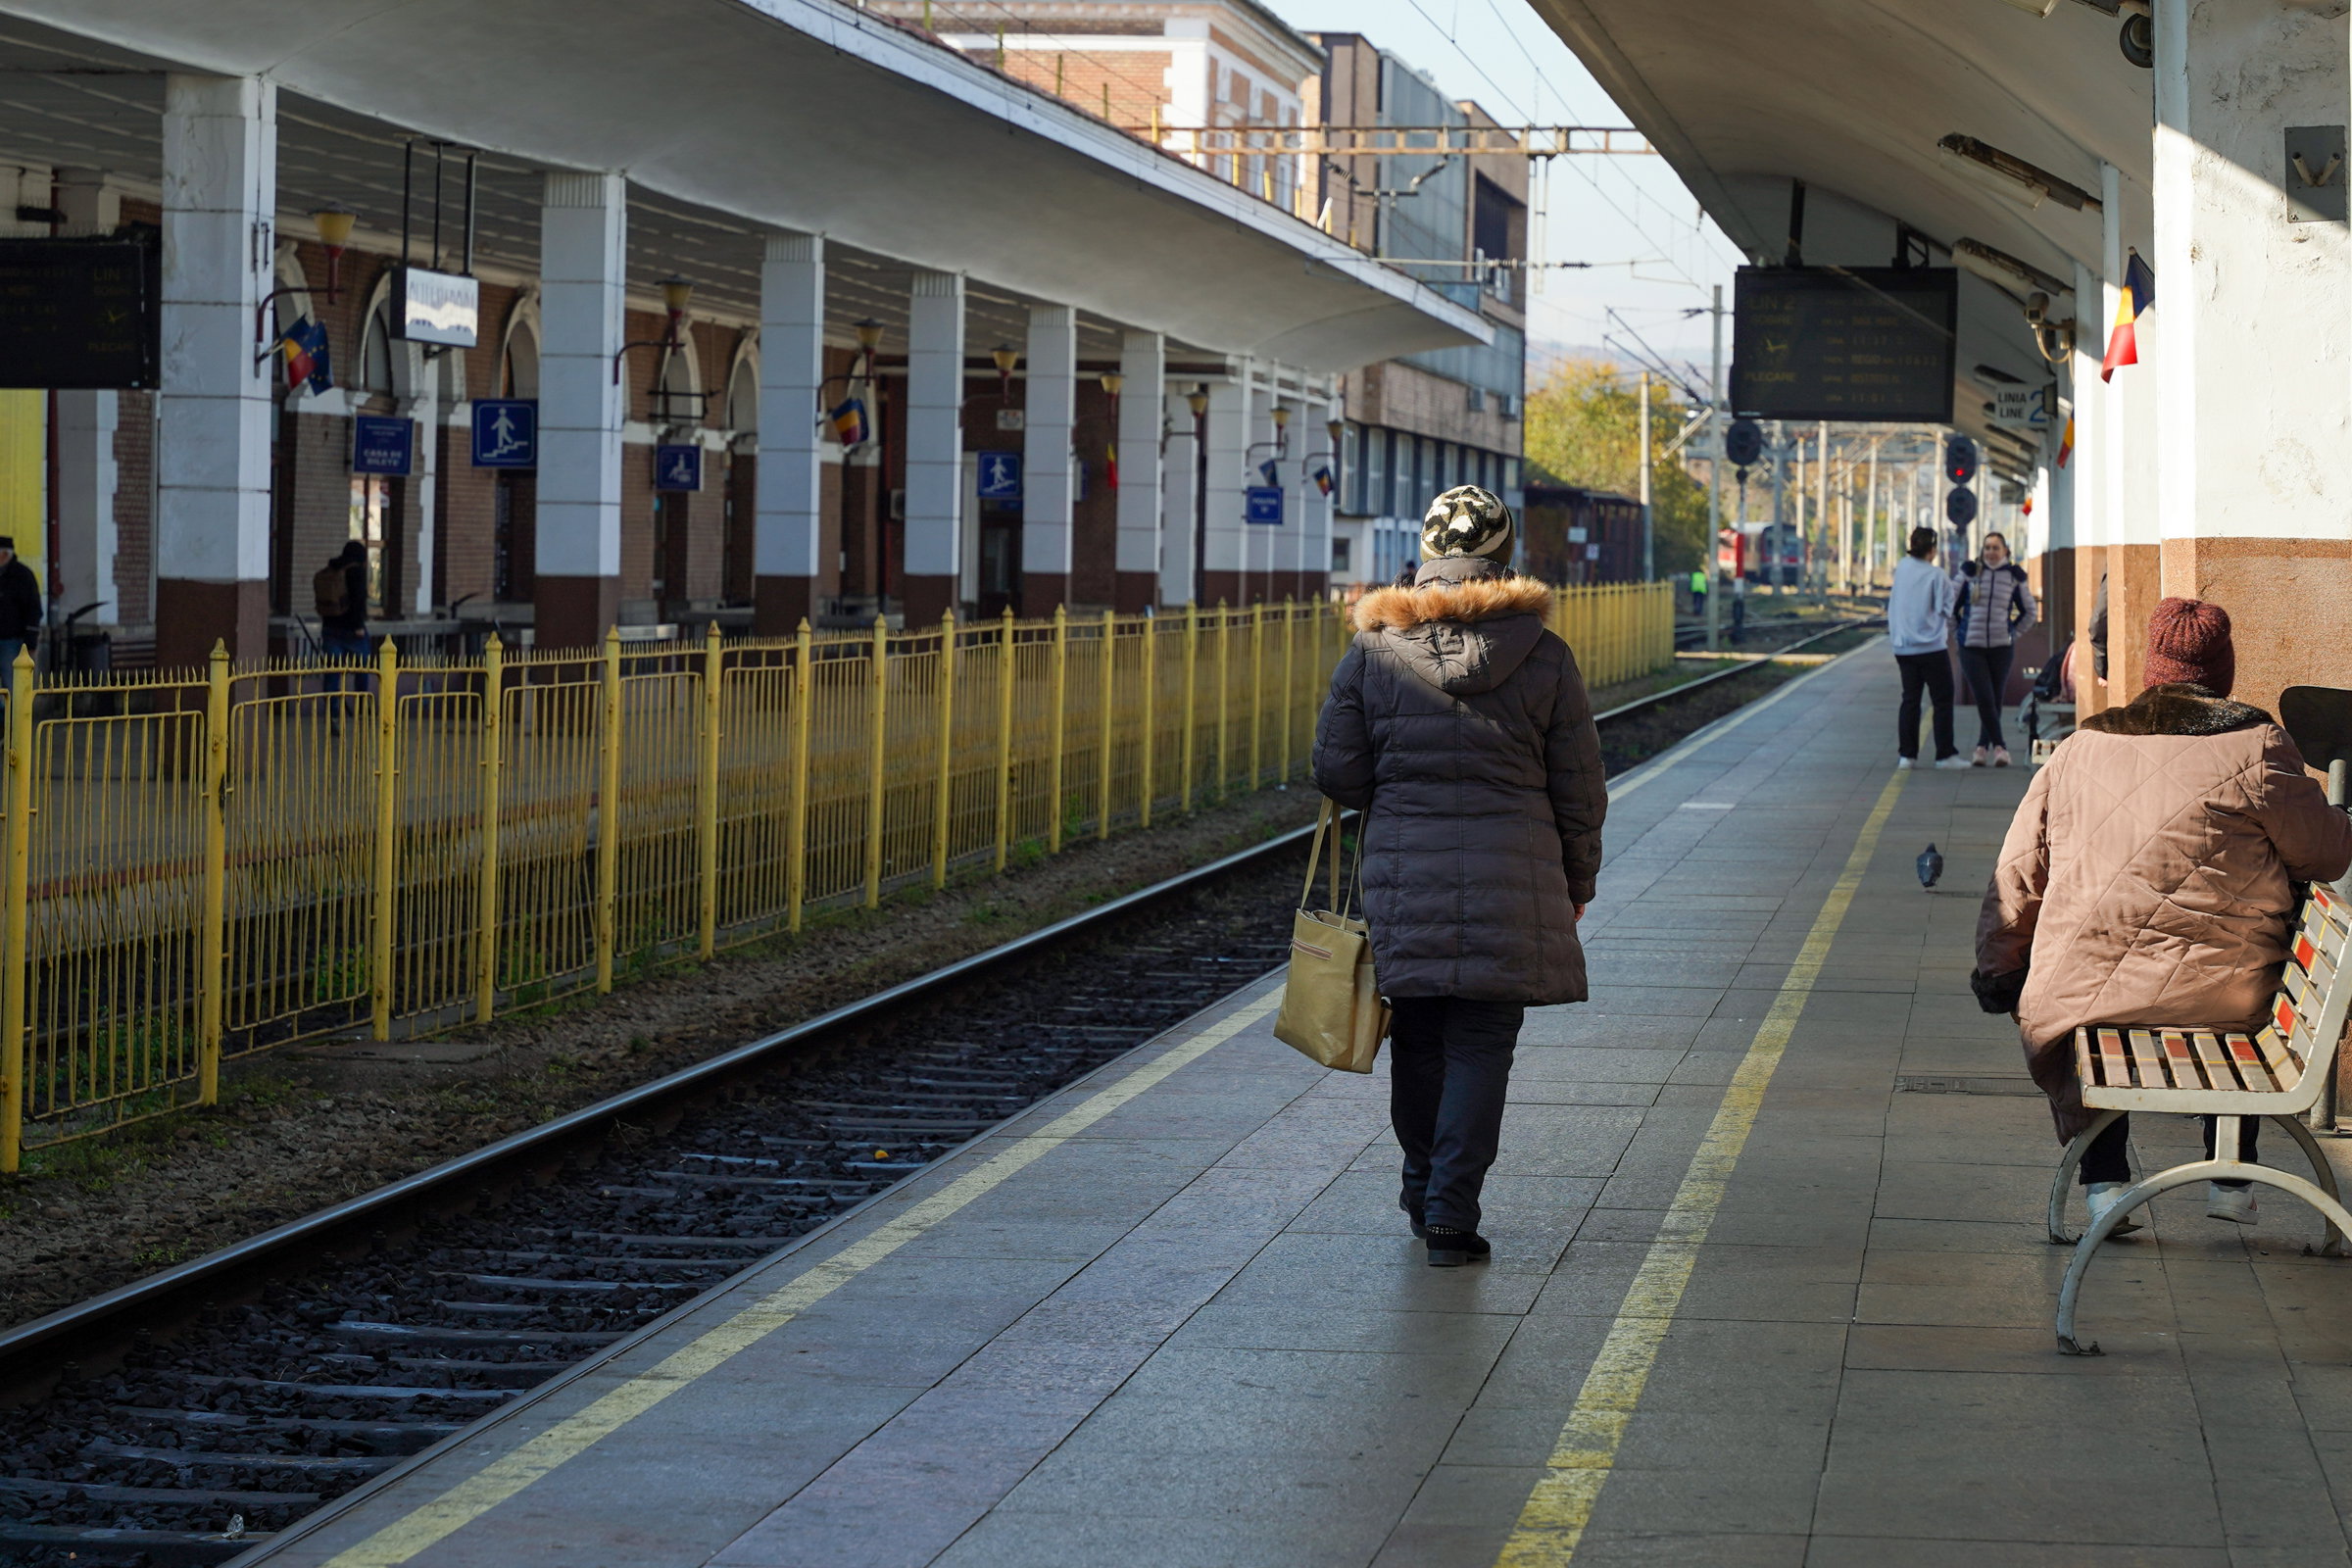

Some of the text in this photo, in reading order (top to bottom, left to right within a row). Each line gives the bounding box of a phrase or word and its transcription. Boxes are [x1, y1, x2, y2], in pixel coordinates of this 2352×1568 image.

[1998, 390, 2046, 422] LINIA 2
[1999, 407, 2024, 418] LINE
